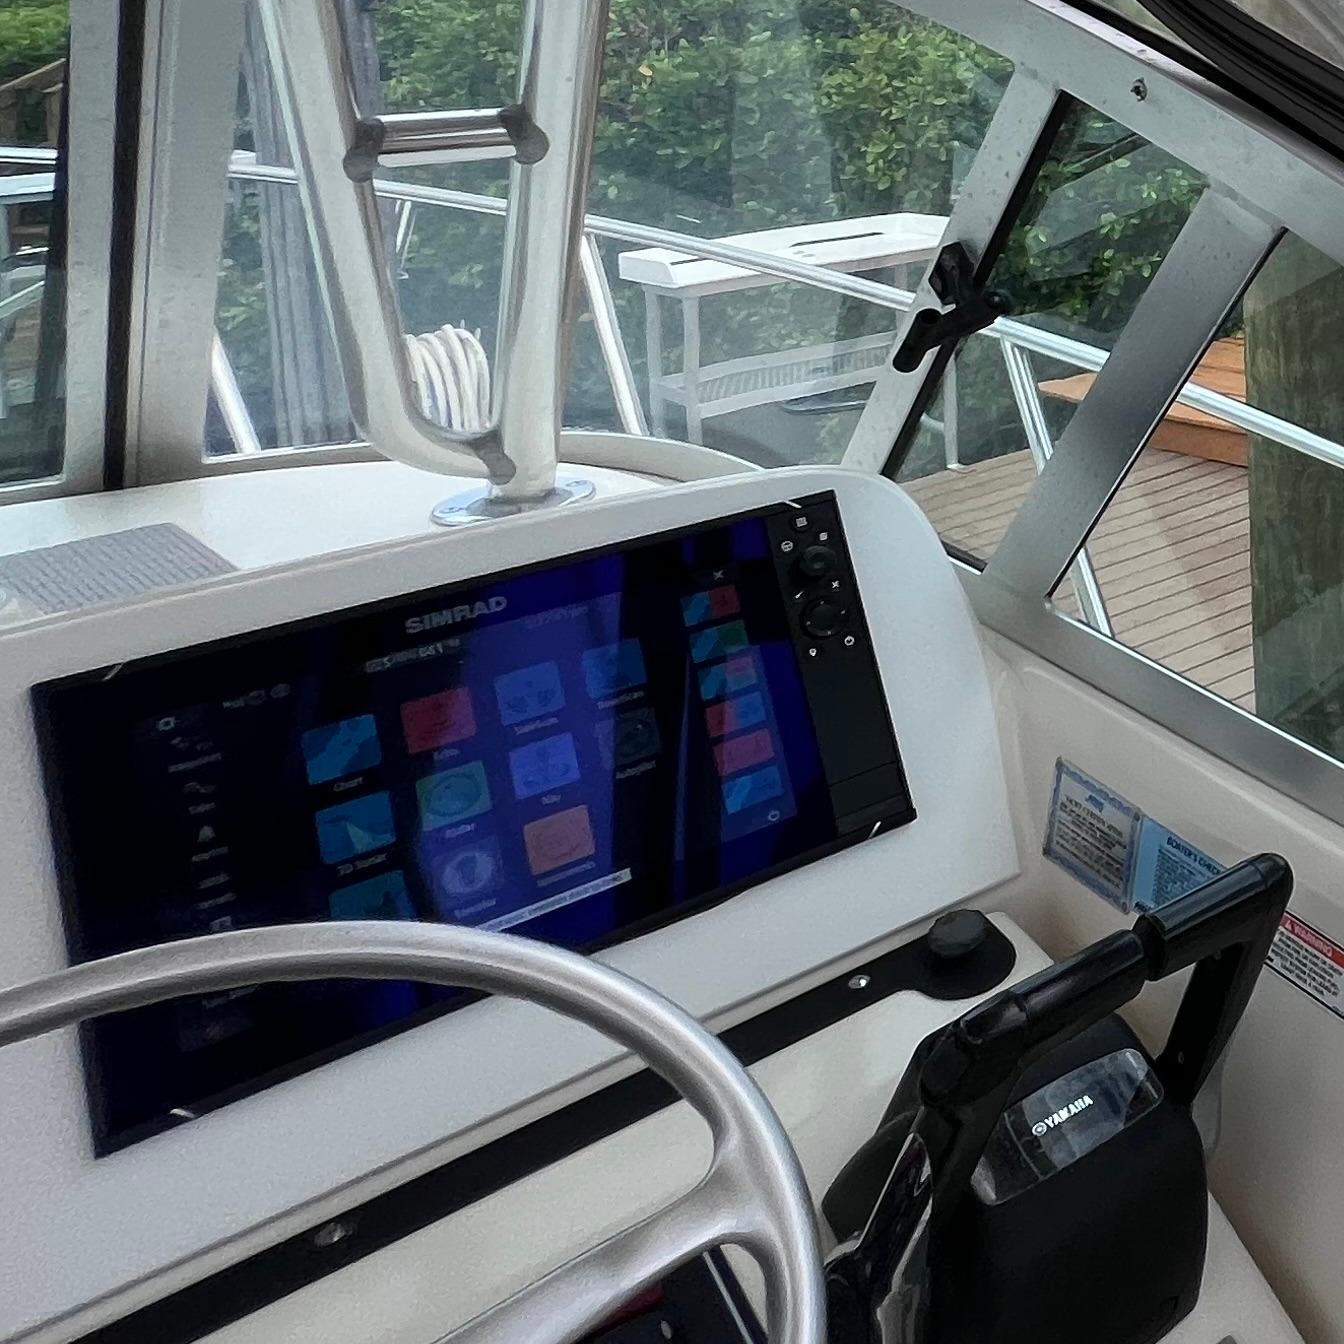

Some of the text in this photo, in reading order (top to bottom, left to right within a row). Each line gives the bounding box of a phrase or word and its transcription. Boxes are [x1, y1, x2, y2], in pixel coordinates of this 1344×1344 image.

[405, 596, 508, 633] SIMRAD
[1294, 924, 1333, 957] WARNING
[1044, 1095, 1094, 1129] YAMAHA
